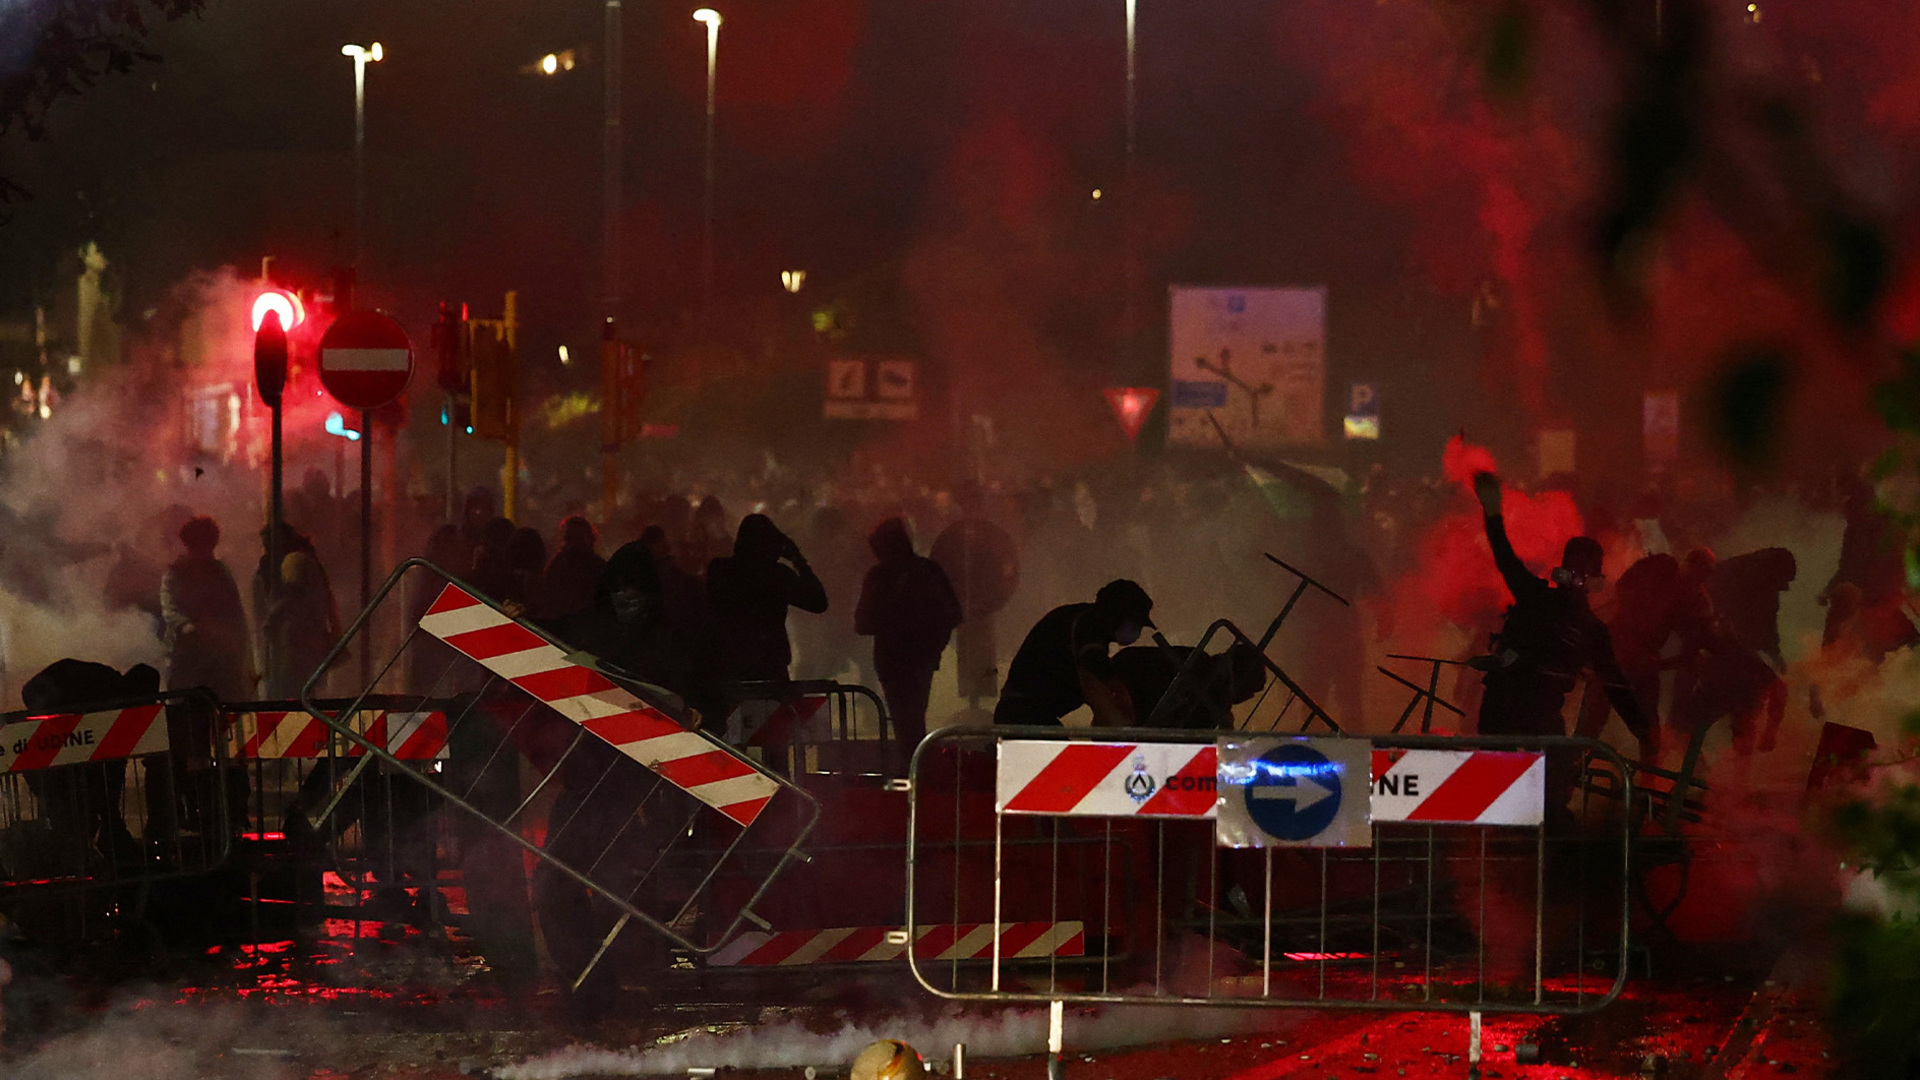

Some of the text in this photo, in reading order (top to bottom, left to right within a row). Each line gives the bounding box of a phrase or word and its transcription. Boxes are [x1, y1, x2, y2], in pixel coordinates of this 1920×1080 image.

[1352, 385, 1374, 411] P
[13, 738, 28, 754] di
[36, 729, 95, 752] UDINE
[1165, 775, 1218, 792] com
